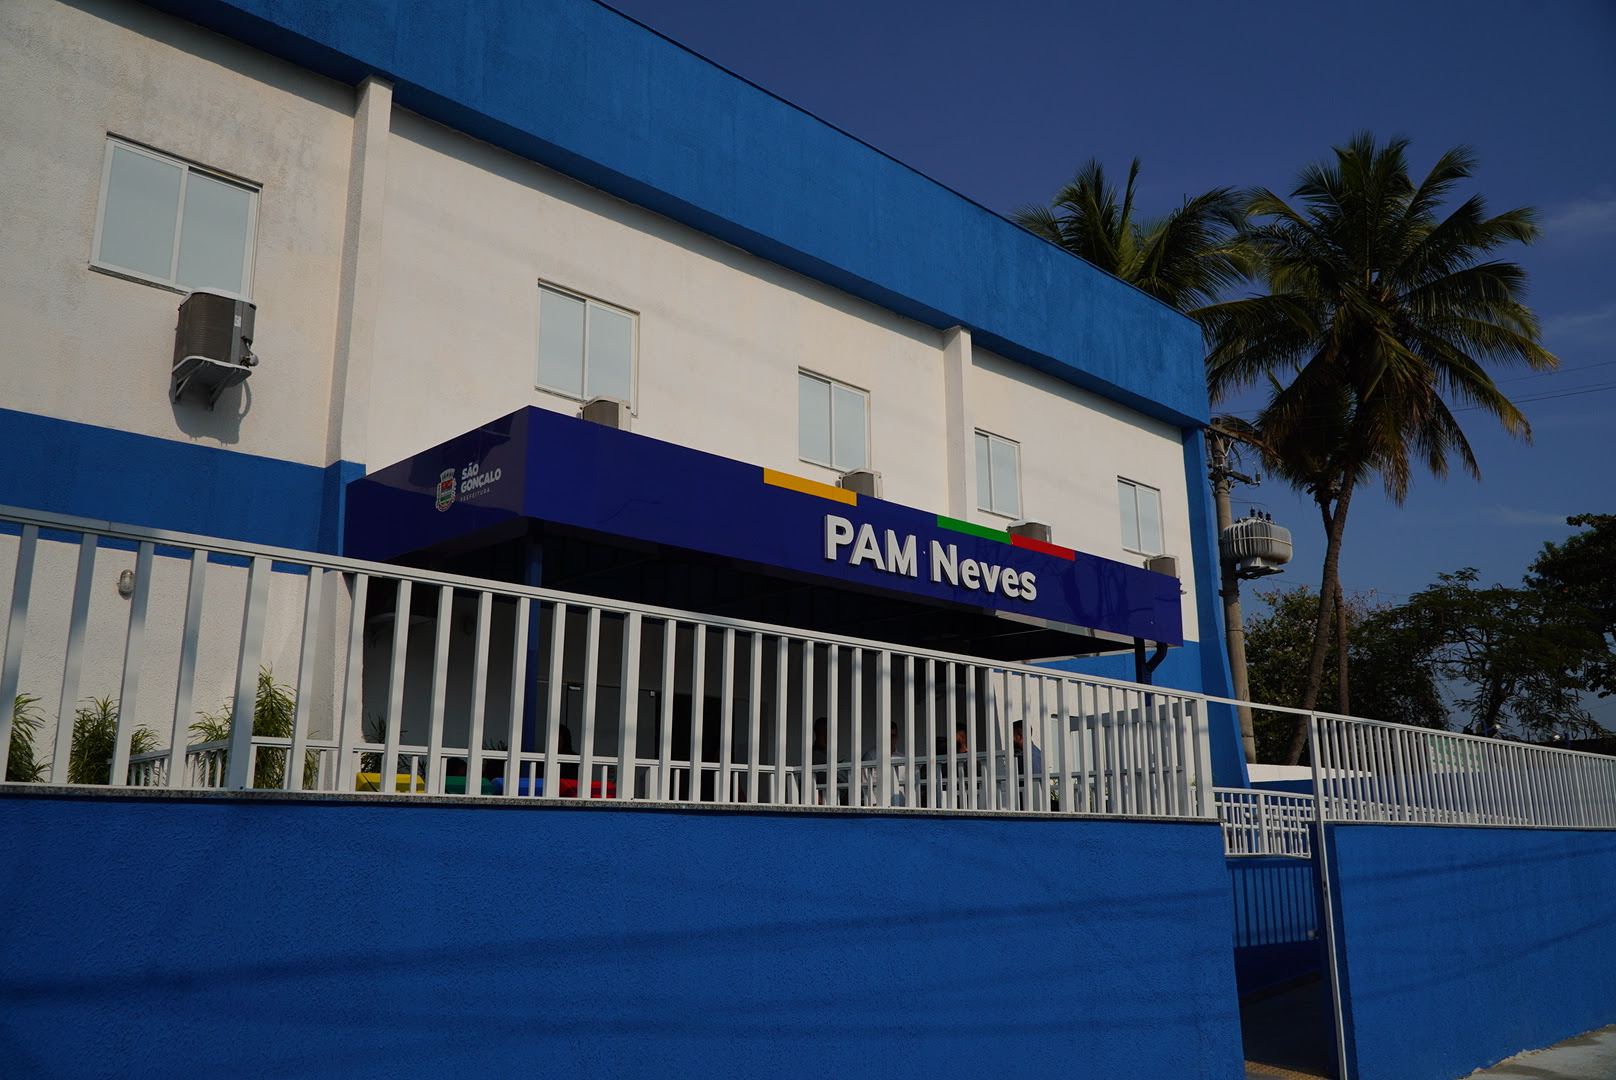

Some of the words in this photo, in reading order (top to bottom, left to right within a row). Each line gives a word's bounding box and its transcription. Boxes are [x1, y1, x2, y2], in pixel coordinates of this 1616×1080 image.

[460, 468, 502, 493] GONÇALO
[461, 462, 479, 480] SÃO
[460, 487, 490, 502] PREFEITURA
[824, 514, 918, 578] PAM
[929, 540, 1037, 601] Neves
